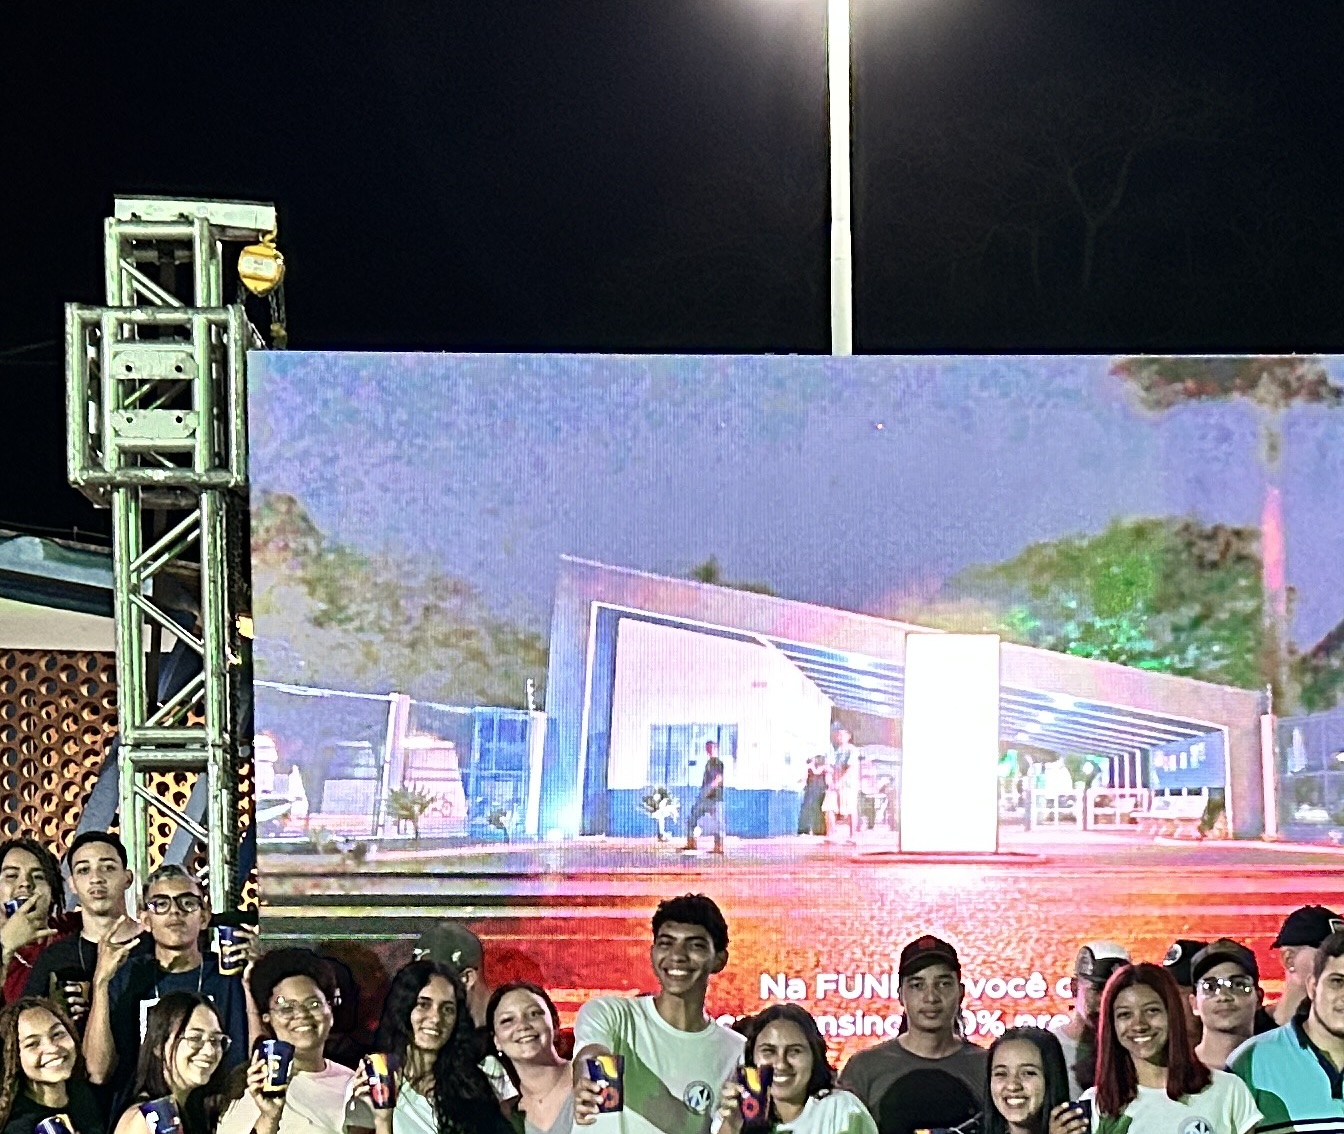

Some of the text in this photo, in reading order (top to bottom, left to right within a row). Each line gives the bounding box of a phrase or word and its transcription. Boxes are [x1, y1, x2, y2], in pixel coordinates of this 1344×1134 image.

[759, 972, 807, 1000] Na
[815, 973, 899, 1000] FUN
[967, 971, 1047, 999] você
[816, 1009, 903, 1037] nsino
